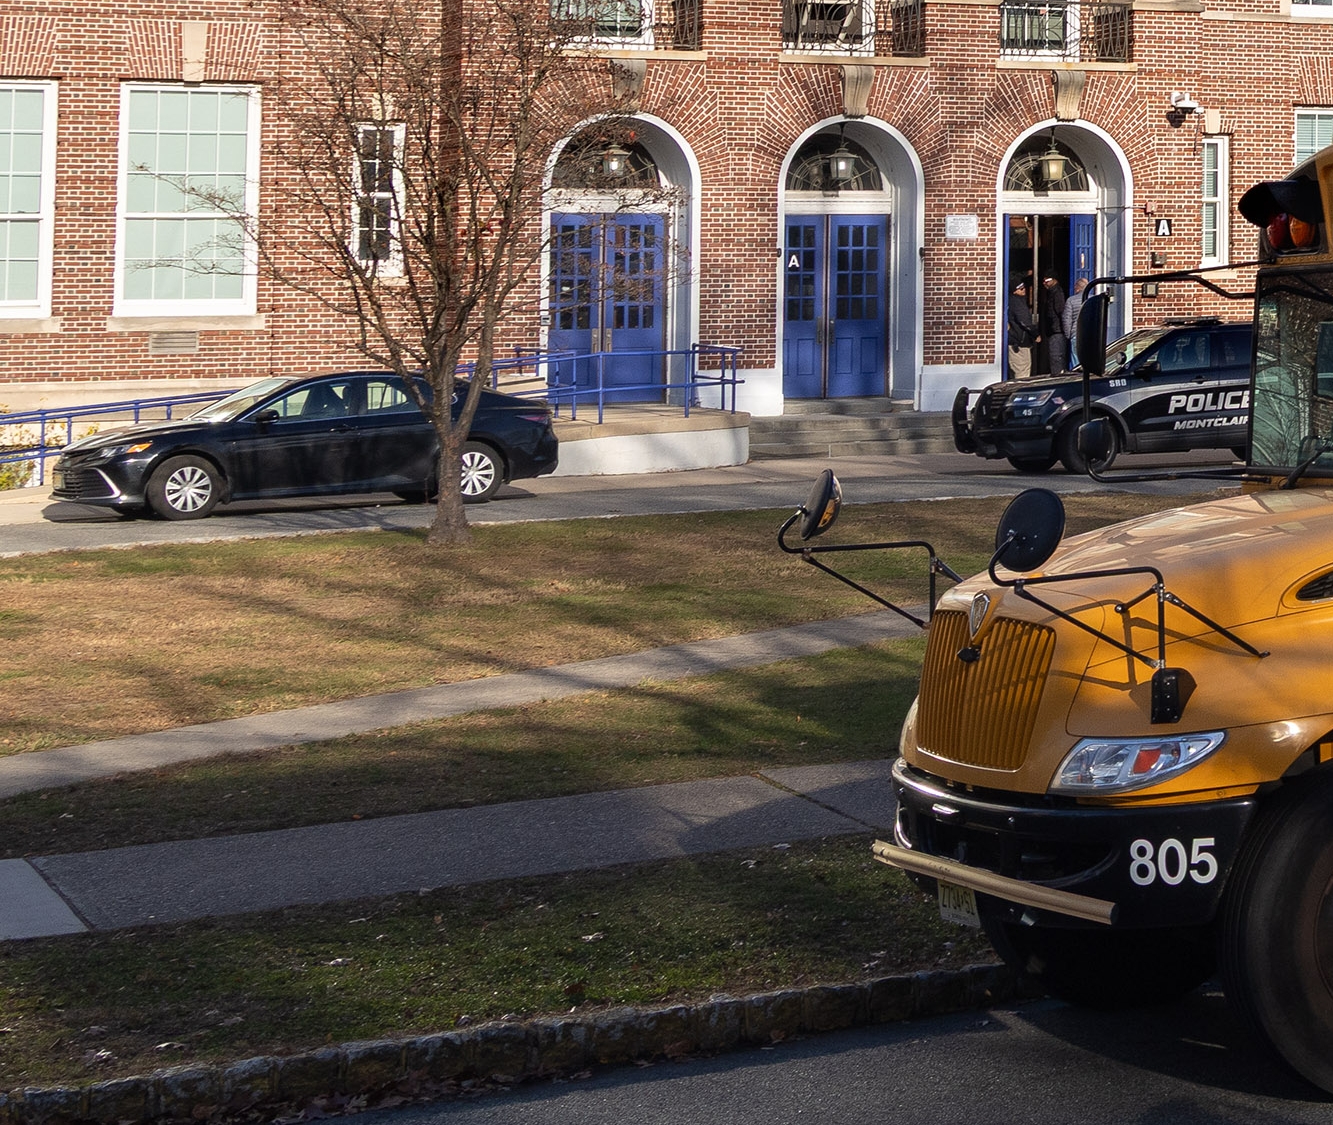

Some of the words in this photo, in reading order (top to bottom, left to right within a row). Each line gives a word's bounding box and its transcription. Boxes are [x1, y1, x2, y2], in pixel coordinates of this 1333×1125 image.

[1157, 219, 1171, 236] A
[788, 254, 800, 268] A
[1109, 378, 1127, 388] SRO
[1129, 837, 1219, 886] 805
